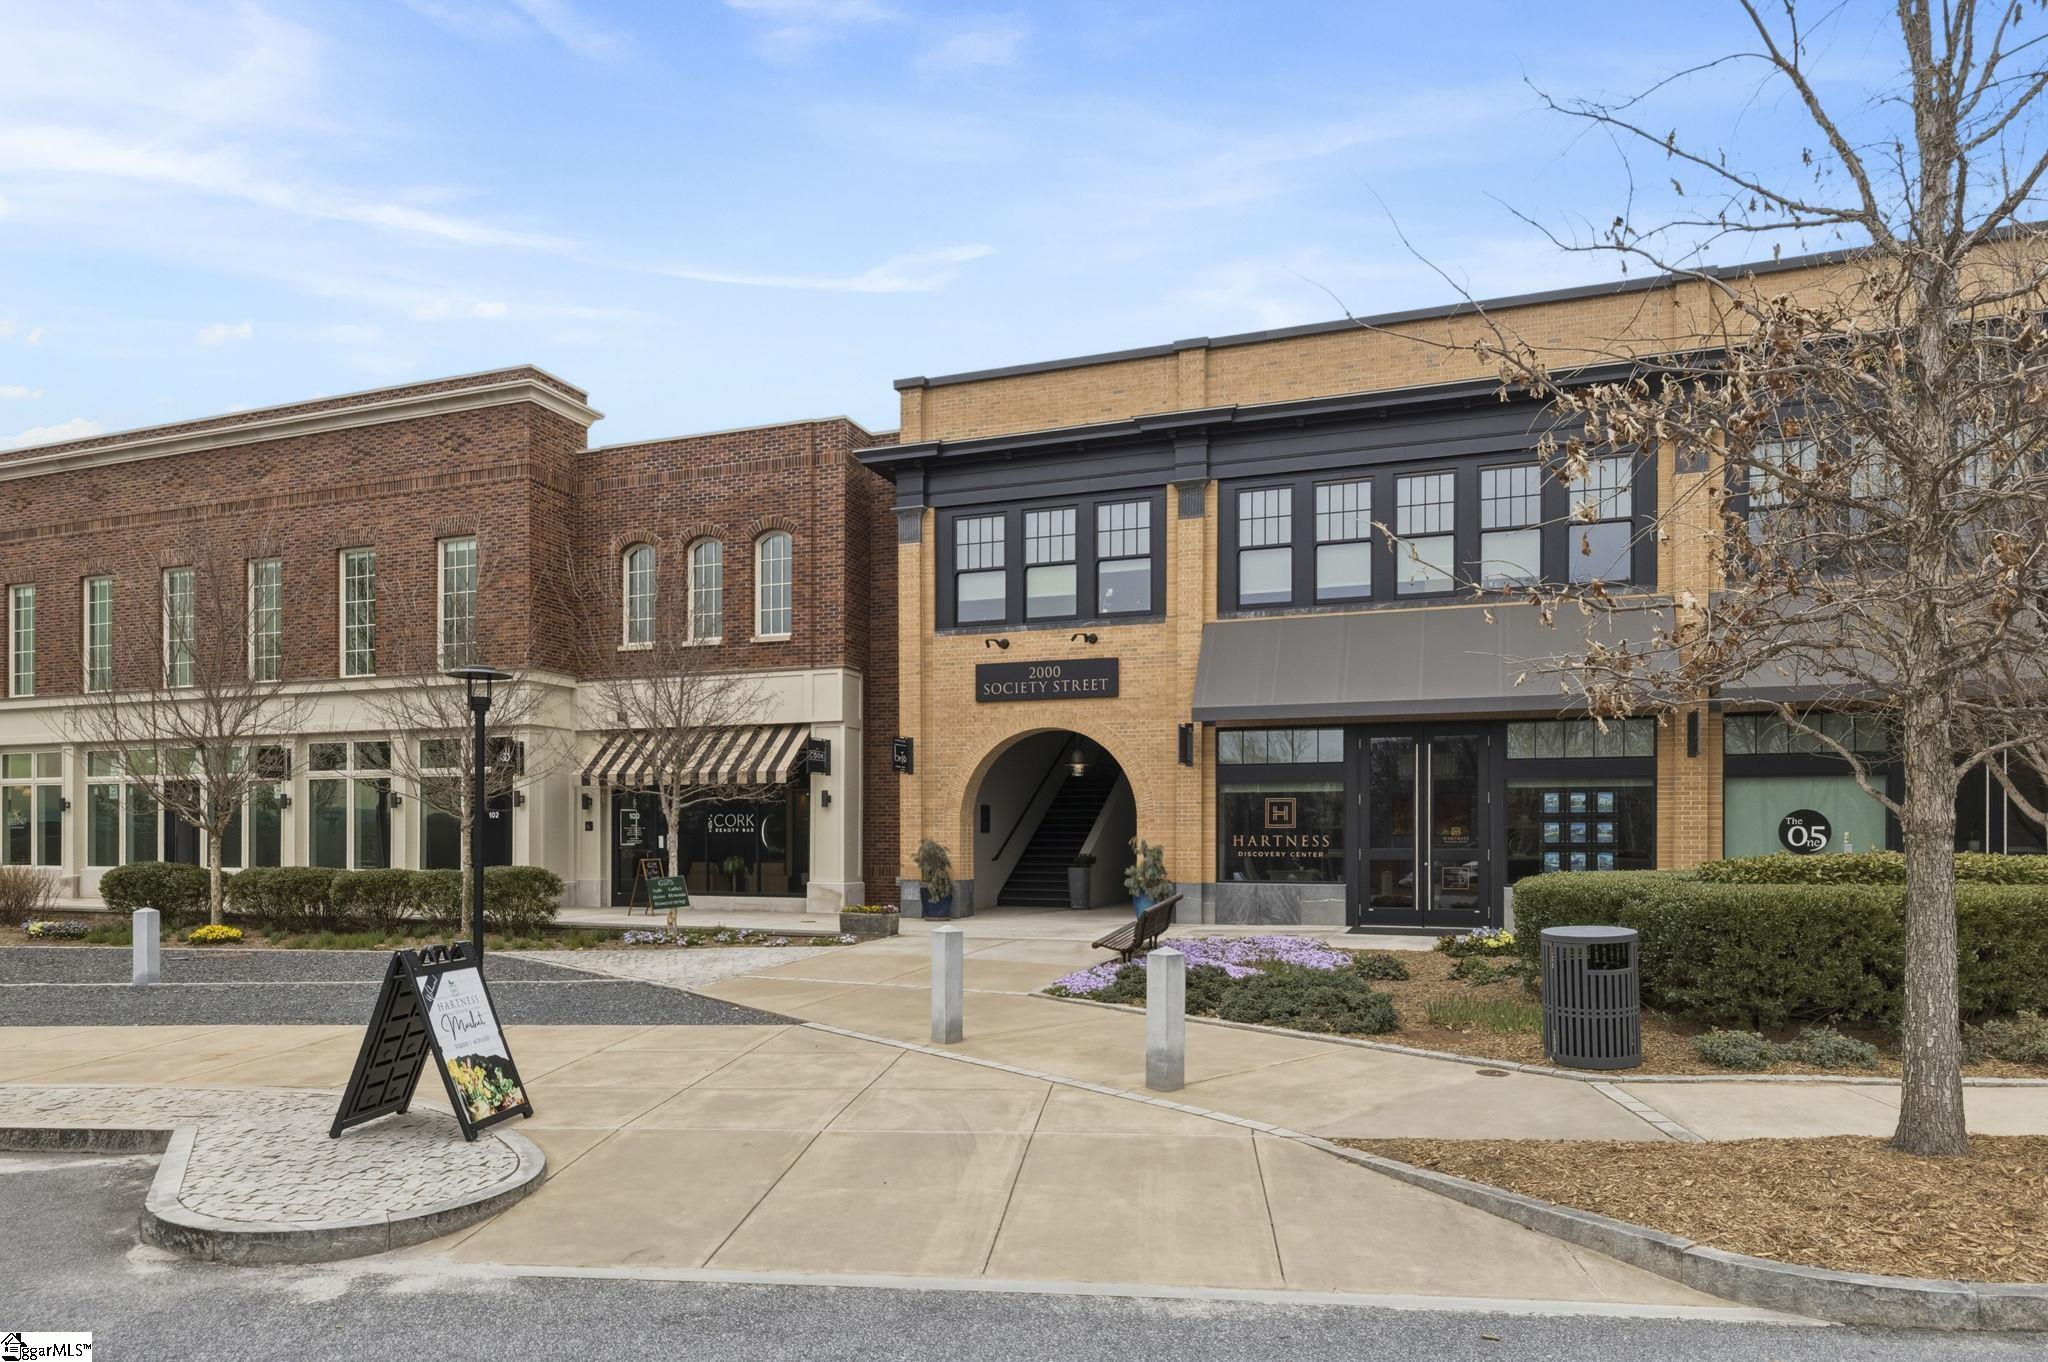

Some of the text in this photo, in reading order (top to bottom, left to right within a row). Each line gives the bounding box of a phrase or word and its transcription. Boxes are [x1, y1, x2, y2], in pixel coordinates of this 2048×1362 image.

[1028, 665, 1061, 679] 2000
[983, 678, 1109, 695] SOCIETY STREET
[488, 811, 500, 819] 102
[629, 812, 640, 820] 100
[713, 813, 755, 827] CORK
[1785, 817, 1803, 825] The
[1232, 834, 1331, 848] HARTNESS
[436, 994, 481, 1013] HARTNESS
[440, 1010, 486, 1041] Market
